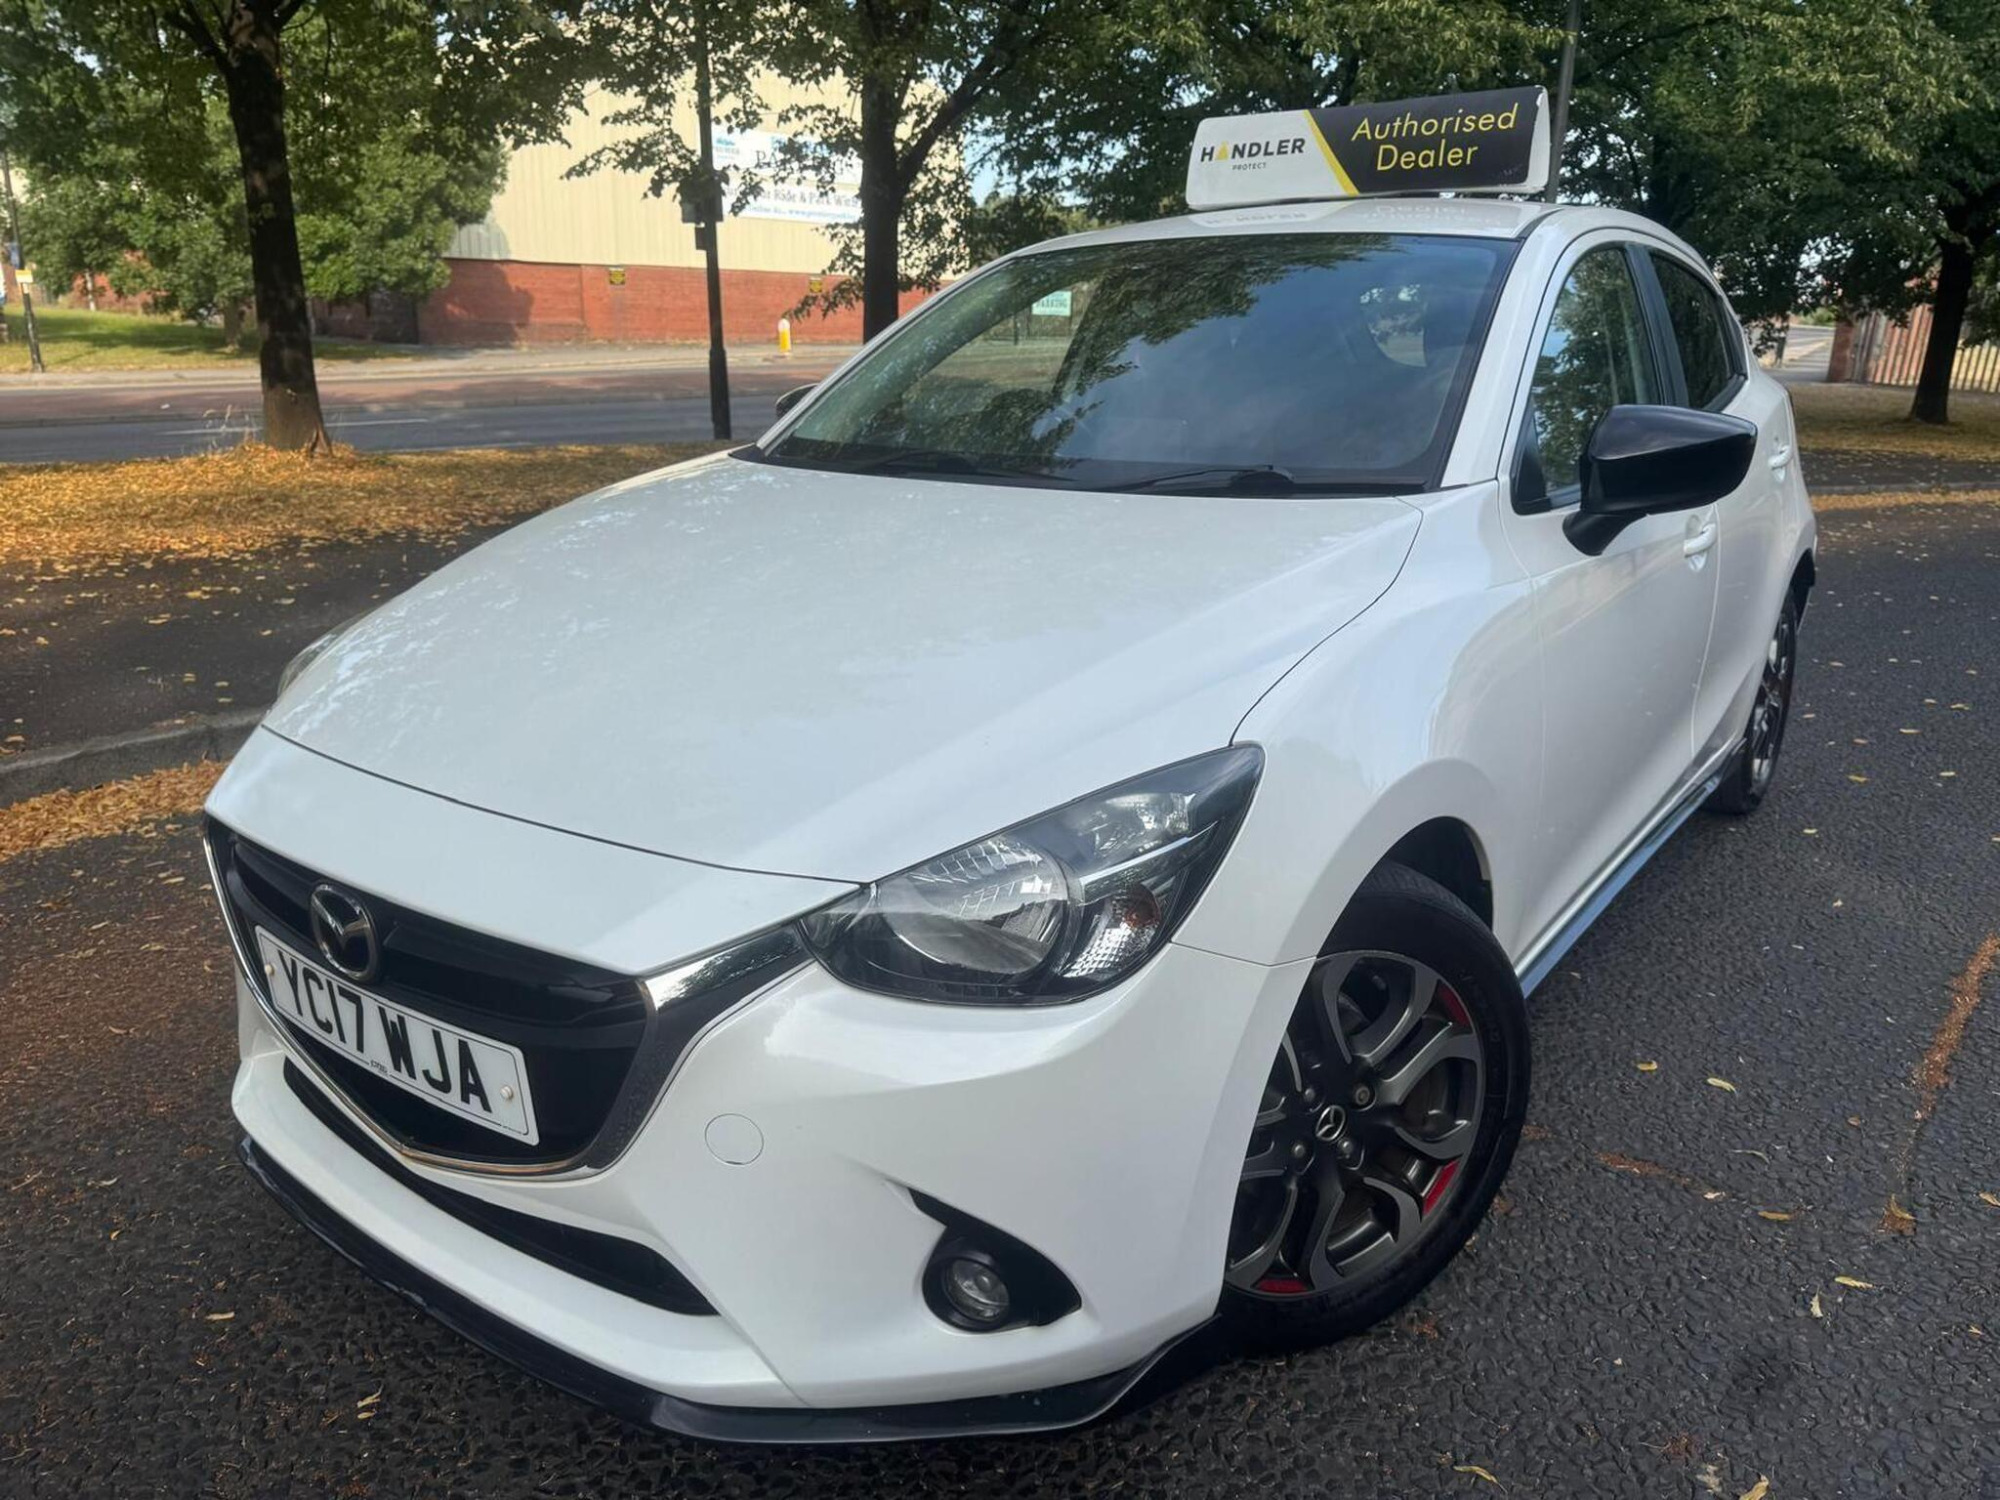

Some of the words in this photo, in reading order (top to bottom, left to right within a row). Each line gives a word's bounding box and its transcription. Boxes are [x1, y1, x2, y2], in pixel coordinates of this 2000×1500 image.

[1351, 102, 1519, 142] Authorised
[1231, 162, 1267, 171] PROTECT
[1376, 138, 1479, 172] Dealer
[277, 949, 364, 1054] YC17
[377, 1005, 493, 1114] WJA
